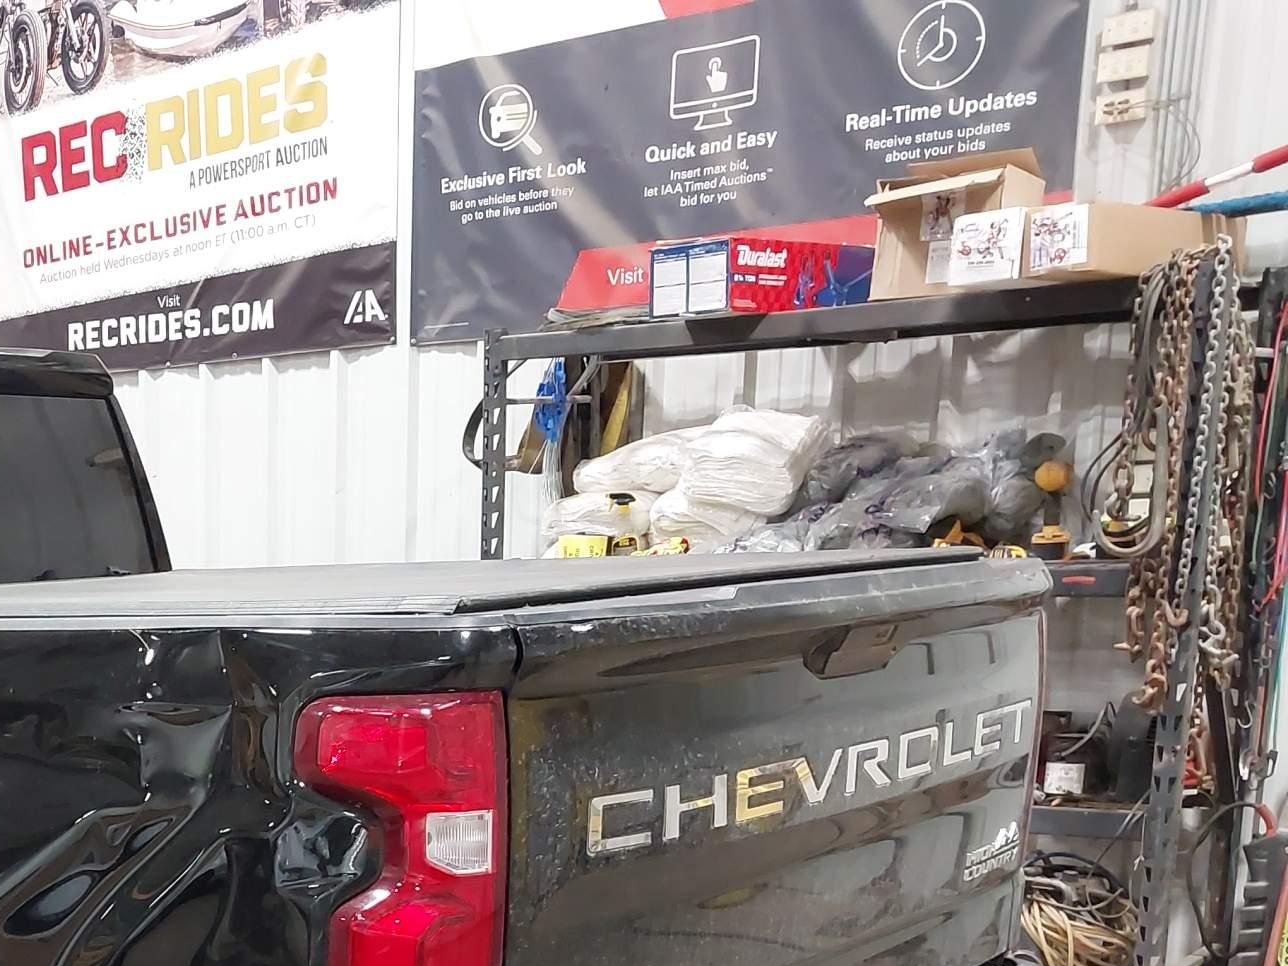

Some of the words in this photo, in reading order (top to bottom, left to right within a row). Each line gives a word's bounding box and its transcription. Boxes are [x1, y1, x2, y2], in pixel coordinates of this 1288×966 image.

[845, 104, 942, 132] Real-Time
[948, 90, 1037, 117] Updates
[22, 111, 128, 202] REC
[145, 52, 328, 171] RIDES
[865, 133, 912, 151] Receive
[915, 128, 953, 144] status
[957, 120, 1011, 139] updates
[645, 141, 696, 163] Quick
[700, 134, 732, 156] and
[737, 130, 778, 149] Easy
[885, 147, 921, 163] about
[924, 144, 953, 160] your
[957, 138, 986, 153] bids
[190, 173, 196, 189] A
[199, 150, 271, 186] POWERSPORT
[275, 137, 328, 166] AUCTION
[441, 171, 505, 194] Exclusive
[509, 165, 542, 183] First
[547, 157, 587, 178] Look
[670, 167, 701, 181] Insert
[703, 164, 727, 176] max
[729, 158, 750, 171] bid,
[450, 199, 463, 211] Bid
[465, 200, 476, 209] on
[478, 193, 516, 207] vehicles
[519, 187, 548, 201] before
[551, 184, 575, 198] they
[644, 186, 658, 197] let
[661, 183, 683, 196] IAA
[684, 178, 717, 193] Timed
[680, 195, 697, 207] bid
[700, 192, 714, 202] for
[717, 190, 737, 204] you
[23, 204, 227, 268] ONLINE-EXCLUSIVE
[234, 176, 338, 221] AUCTION
[461, 214, 473, 225] go
[475, 210, 484, 220] to
[486, 207, 500, 218] the
[503, 205, 520, 217] live
[523, 200, 558, 214] auction
[40, 266, 77, 284] Auction
[80, 261, 101, 276] held
[104, 248, 170, 271] Wednesdays
[173, 245, 184, 257] at
[185, 239, 212, 253] noon
[215, 233, 228, 246] ET
[230, 224, 264, 245] (11:00
[736, 244, 788, 269] Duralast
[607, 266, 644, 286] Visit
[157, 294, 181, 308] Visit
[67, 299, 275, 351] RECRIDES.COM
[587, 698, 1032, 857] CHEVROLET
